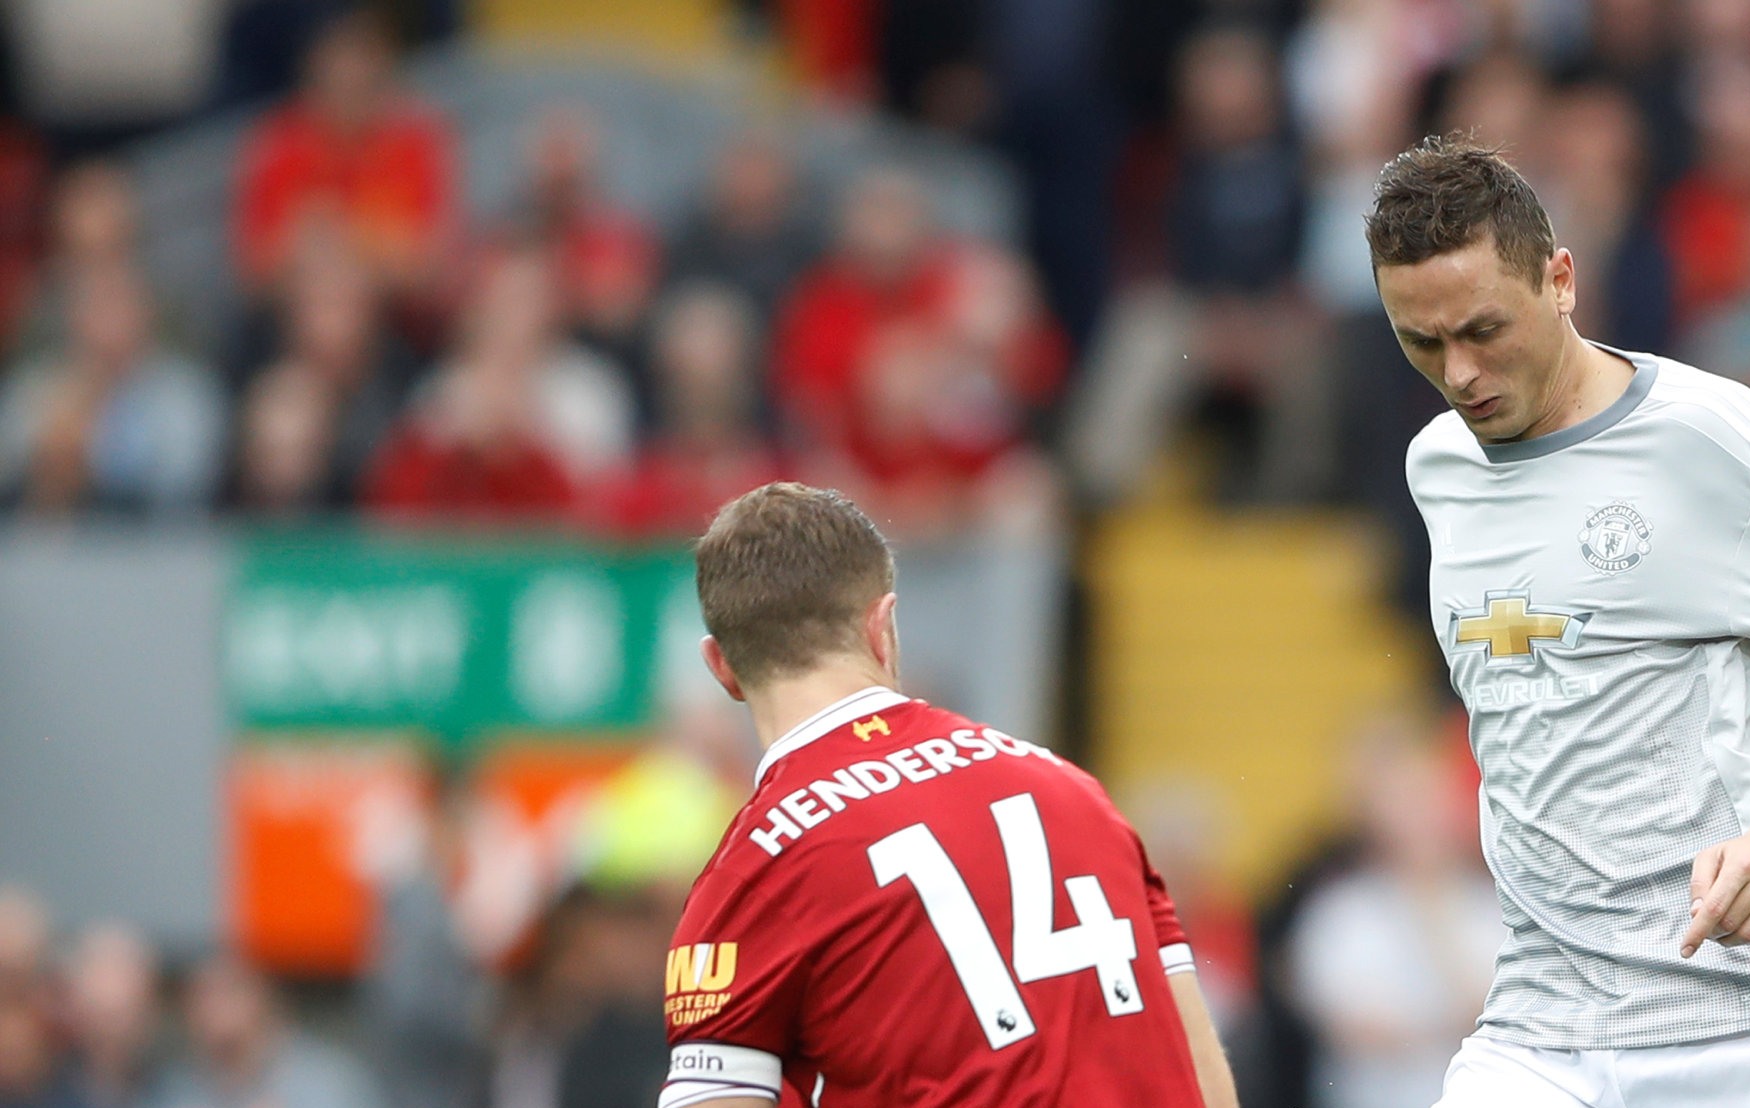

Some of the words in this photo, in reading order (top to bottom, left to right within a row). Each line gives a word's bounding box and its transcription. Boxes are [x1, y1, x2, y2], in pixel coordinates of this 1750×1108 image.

[1589, 506, 1648, 536] MANCHESTER
[1588, 553, 1629, 570] UNITED
[1465, 672, 1603, 708] EVROLET
[749, 727, 1063, 858] HENDERSO
[866, 792, 1144, 1051] 14
[665, 942, 739, 997] WU
[665, 992, 731, 1015] ESTERN
[672, 1006, 722, 1027] UNIO
[672, 1049, 724, 1072] tain
